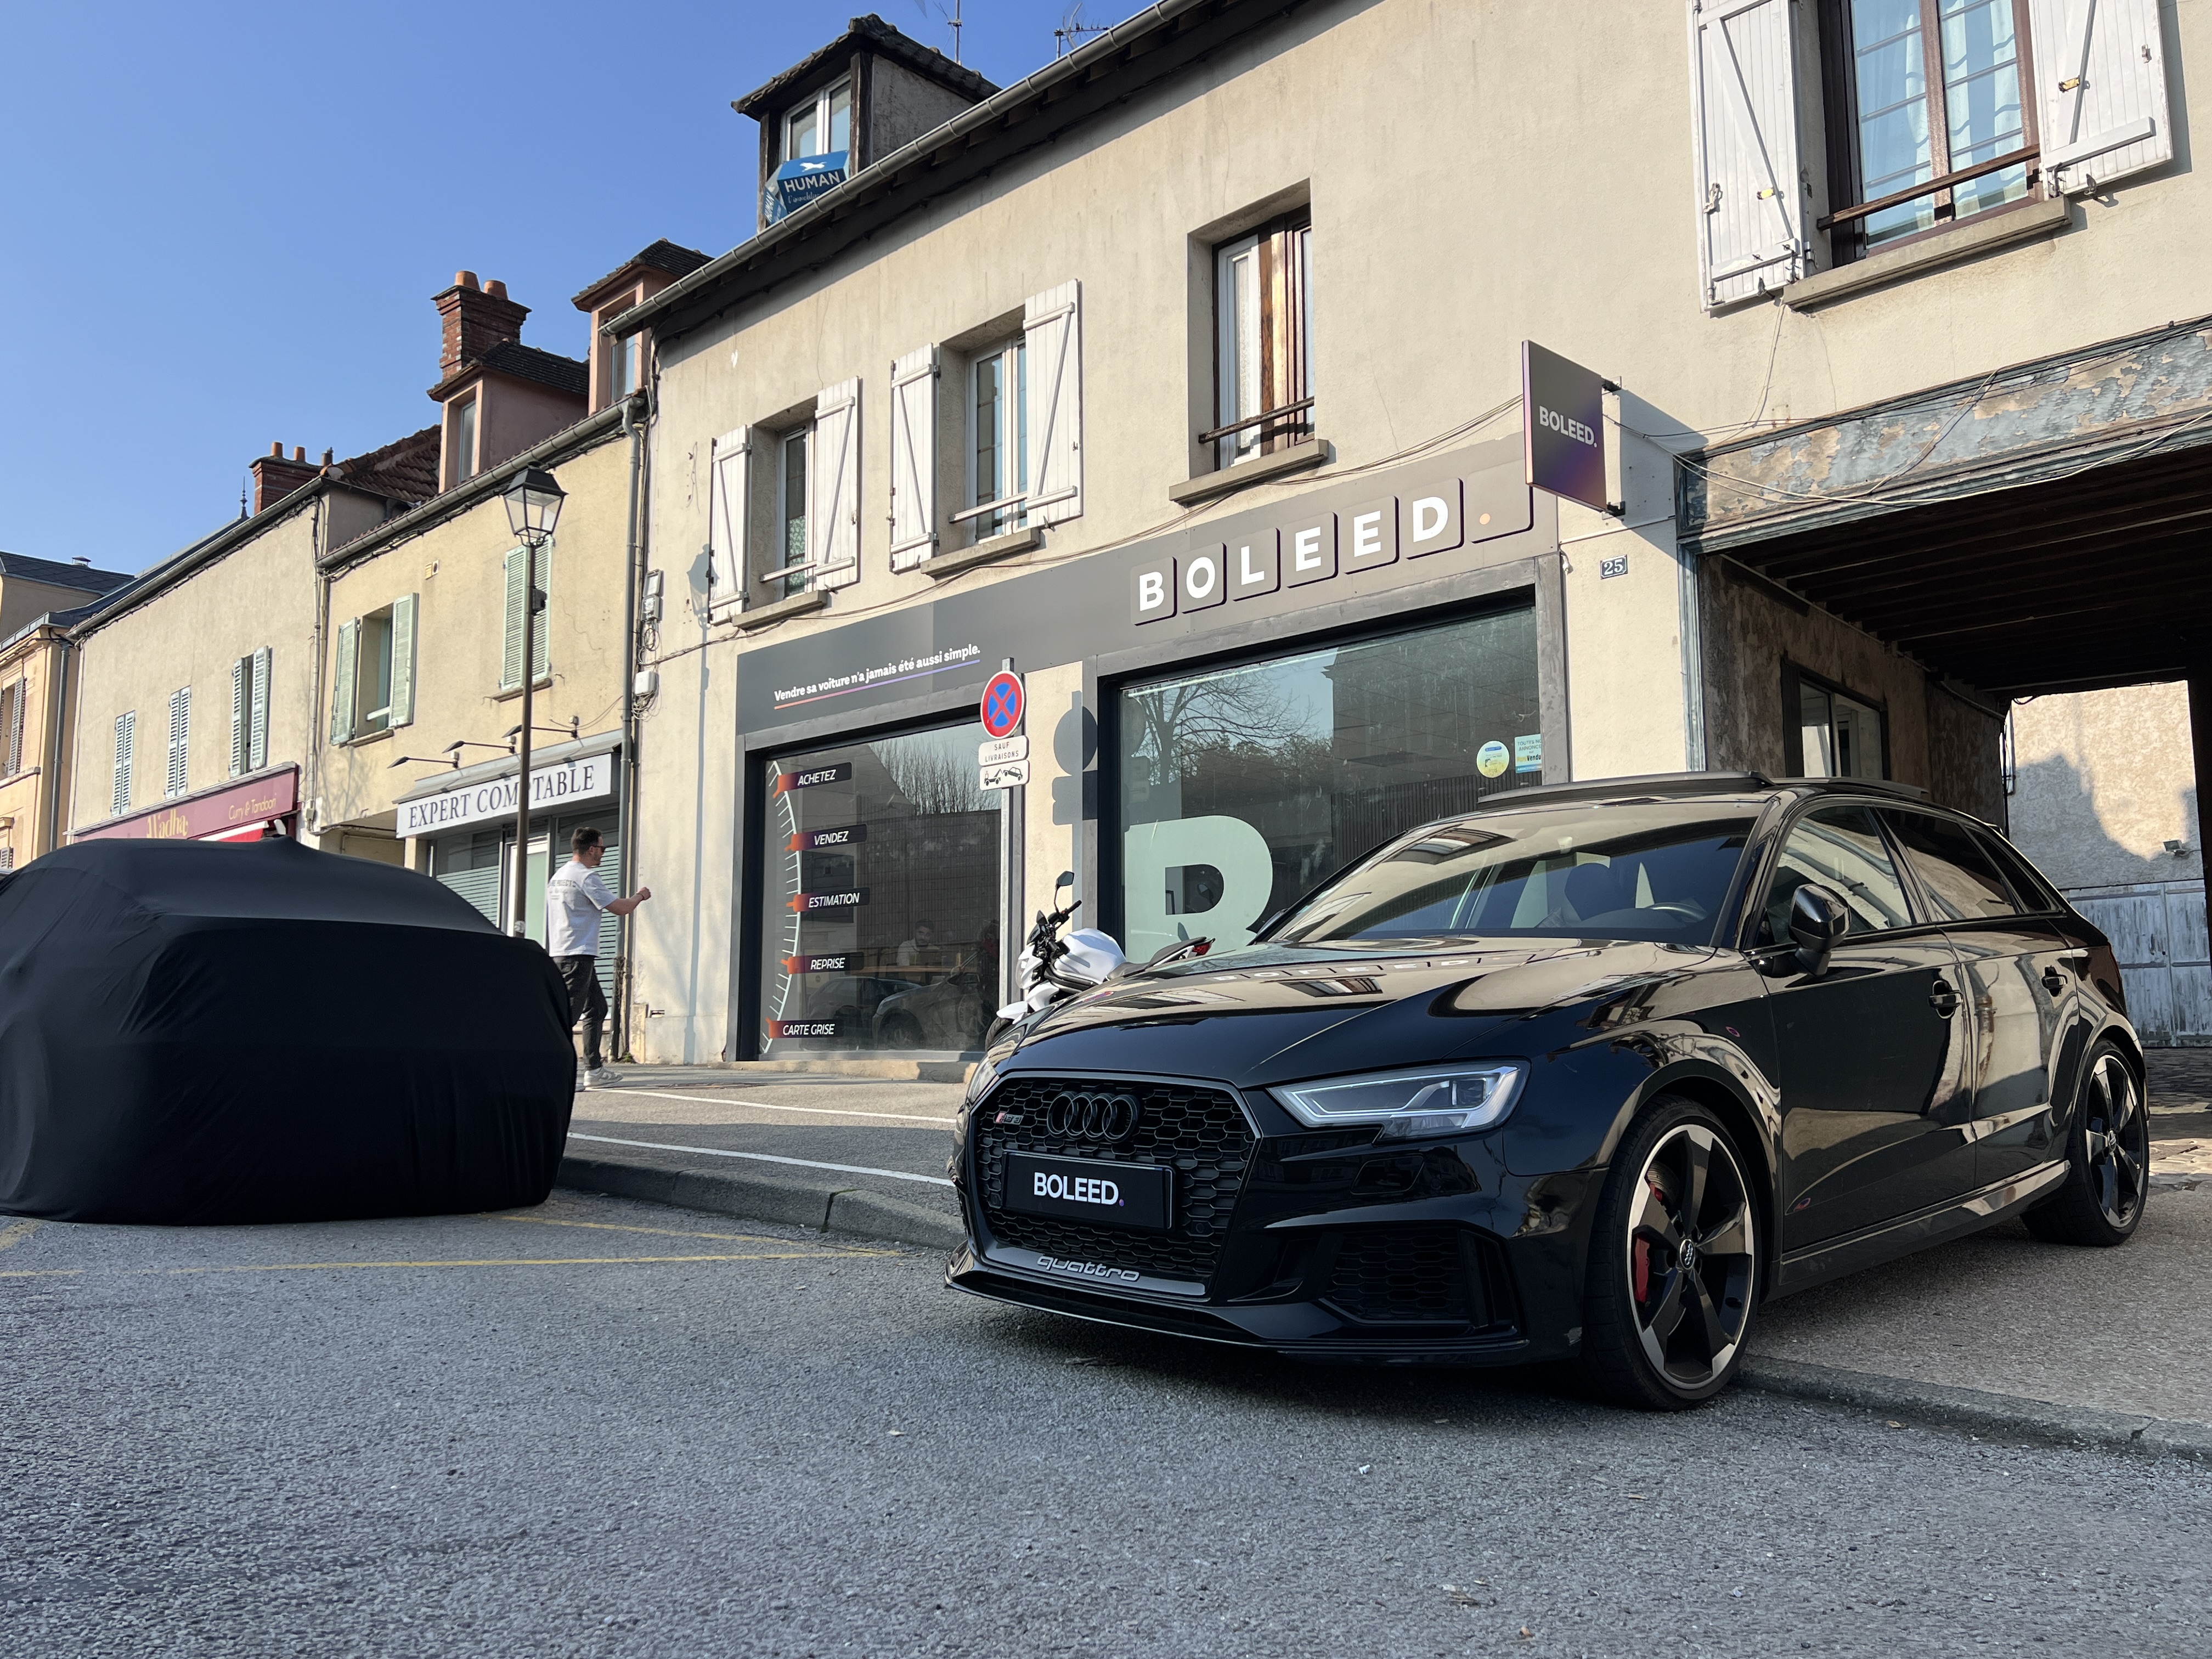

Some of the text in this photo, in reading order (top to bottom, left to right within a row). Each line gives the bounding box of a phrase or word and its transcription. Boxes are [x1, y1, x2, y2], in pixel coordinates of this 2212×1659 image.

[784, 171, 840, 193] HUMAN
[1539, 405, 1598, 448] BOLEED.
[1604, 558, 1623, 575] 25
[774, 643, 981, 701] Vendre sa voiture n'a jamais été aussi simple.
[995, 742, 1009, 751] SAUF
[985, 751, 1019, 762] LIVRAISONS
[798, 769, 836, 786] ACHETEZ
[408, 765, 595, 828] EXPERT COMTABLE
[229, 805, 244, 821] Curry
[251, 793, 277, 814] Tandoori
[814, 831, 849, 845] VENDEZ
[808, 893, 860, 908] ESTIMATION
[810, 957, 845, 970] REPRISE
[783, 1023, 835, 1035] CARTE GRISE
[1034, 1172, 1125, 1207] BOLEED.
[1037, 1255, 1140, 1282] quattro
